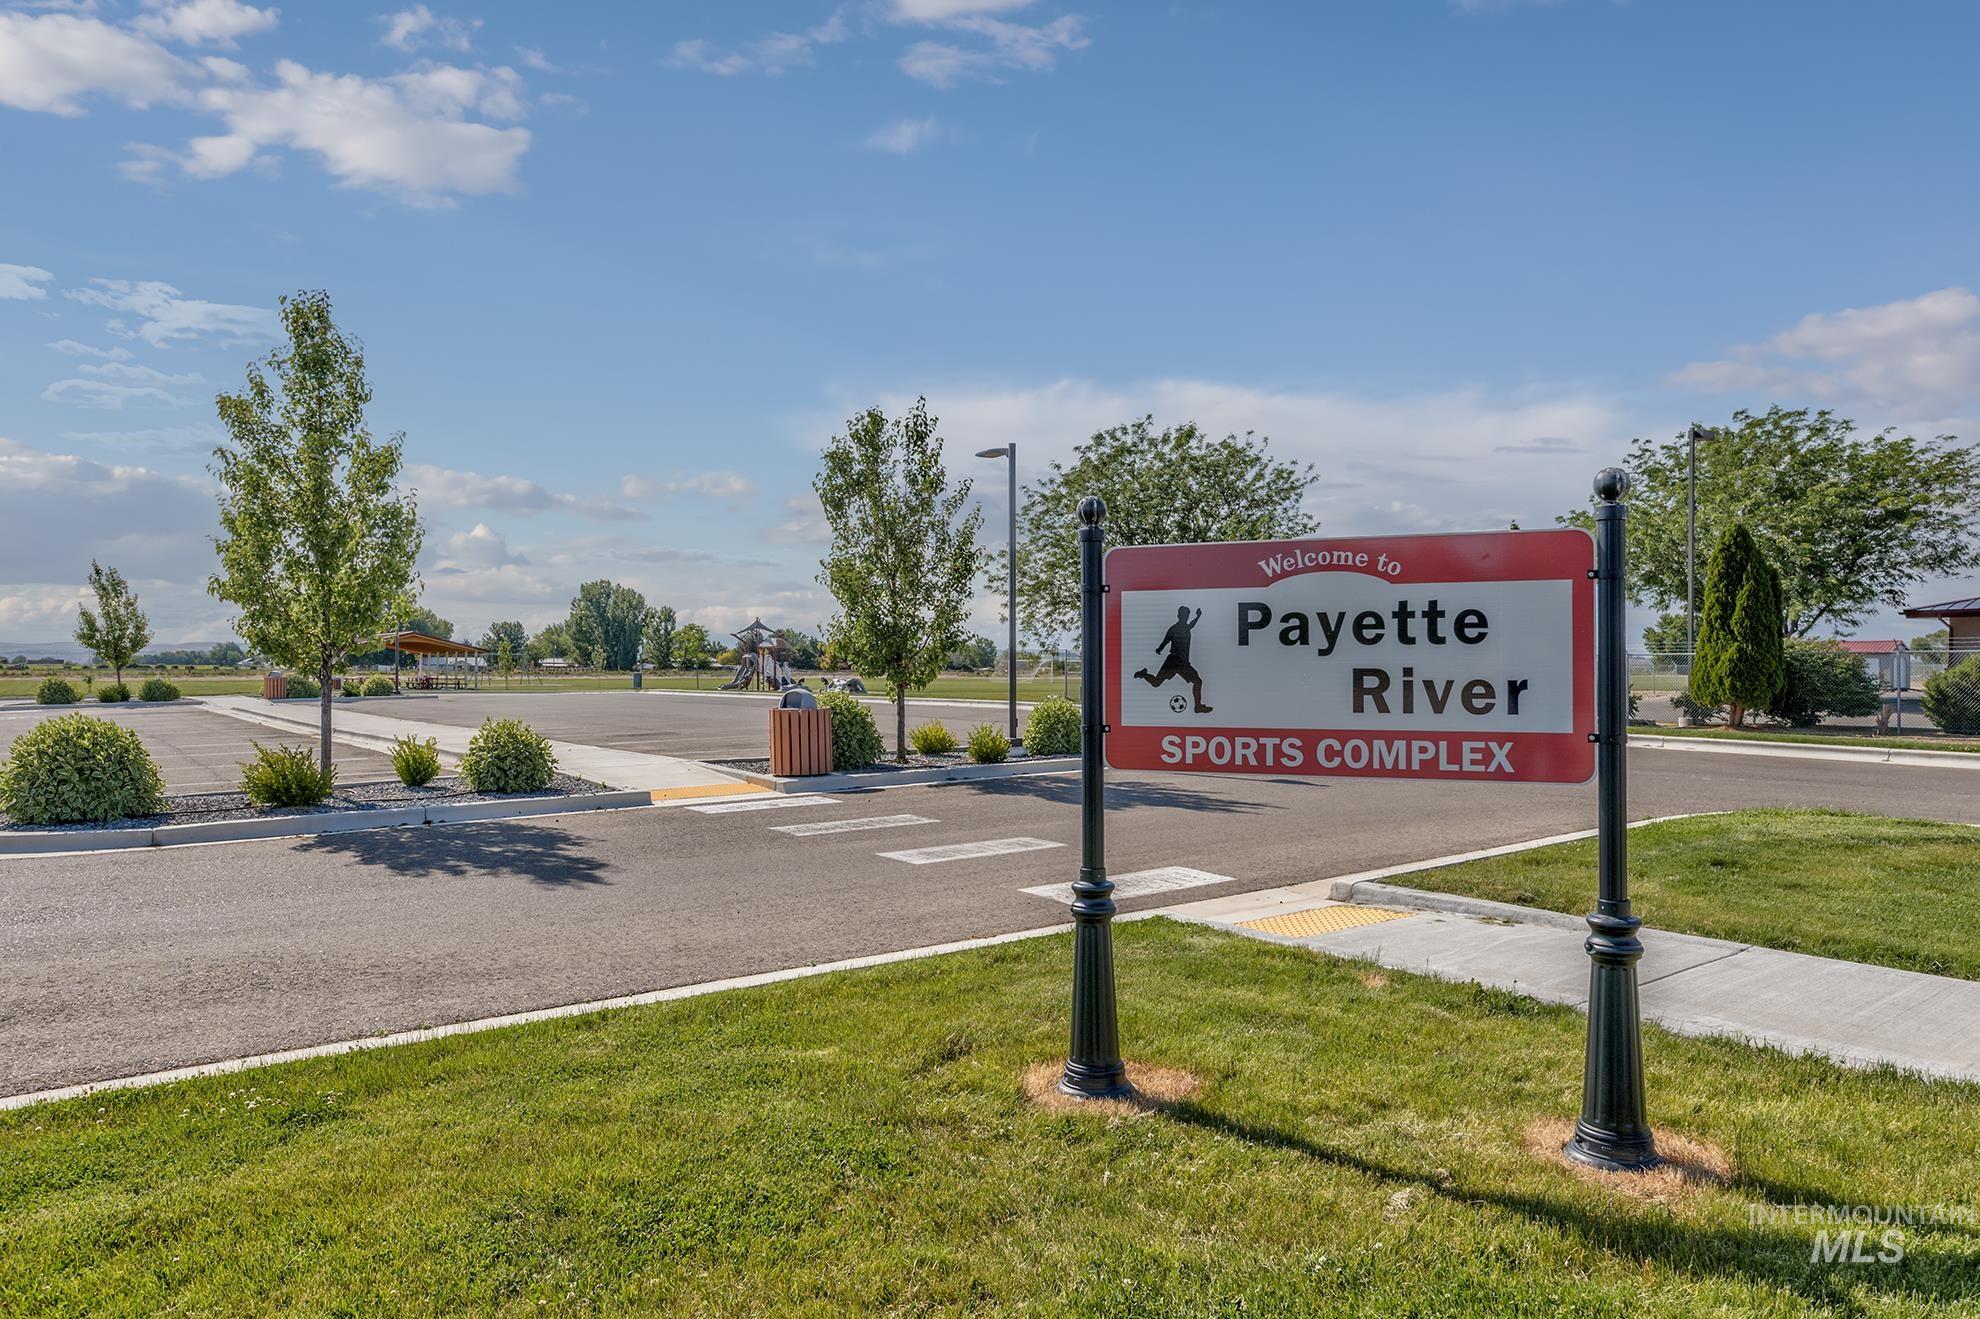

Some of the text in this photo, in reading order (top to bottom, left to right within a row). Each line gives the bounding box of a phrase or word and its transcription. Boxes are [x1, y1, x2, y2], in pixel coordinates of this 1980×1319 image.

[1257, 548, 1402, 578] Welcome to
[1237, 599, 1489, 657] Payette
[1352, 666, 1529, 716] River
[1160, 735, 1516, 773] SPORTS COMPLEX
